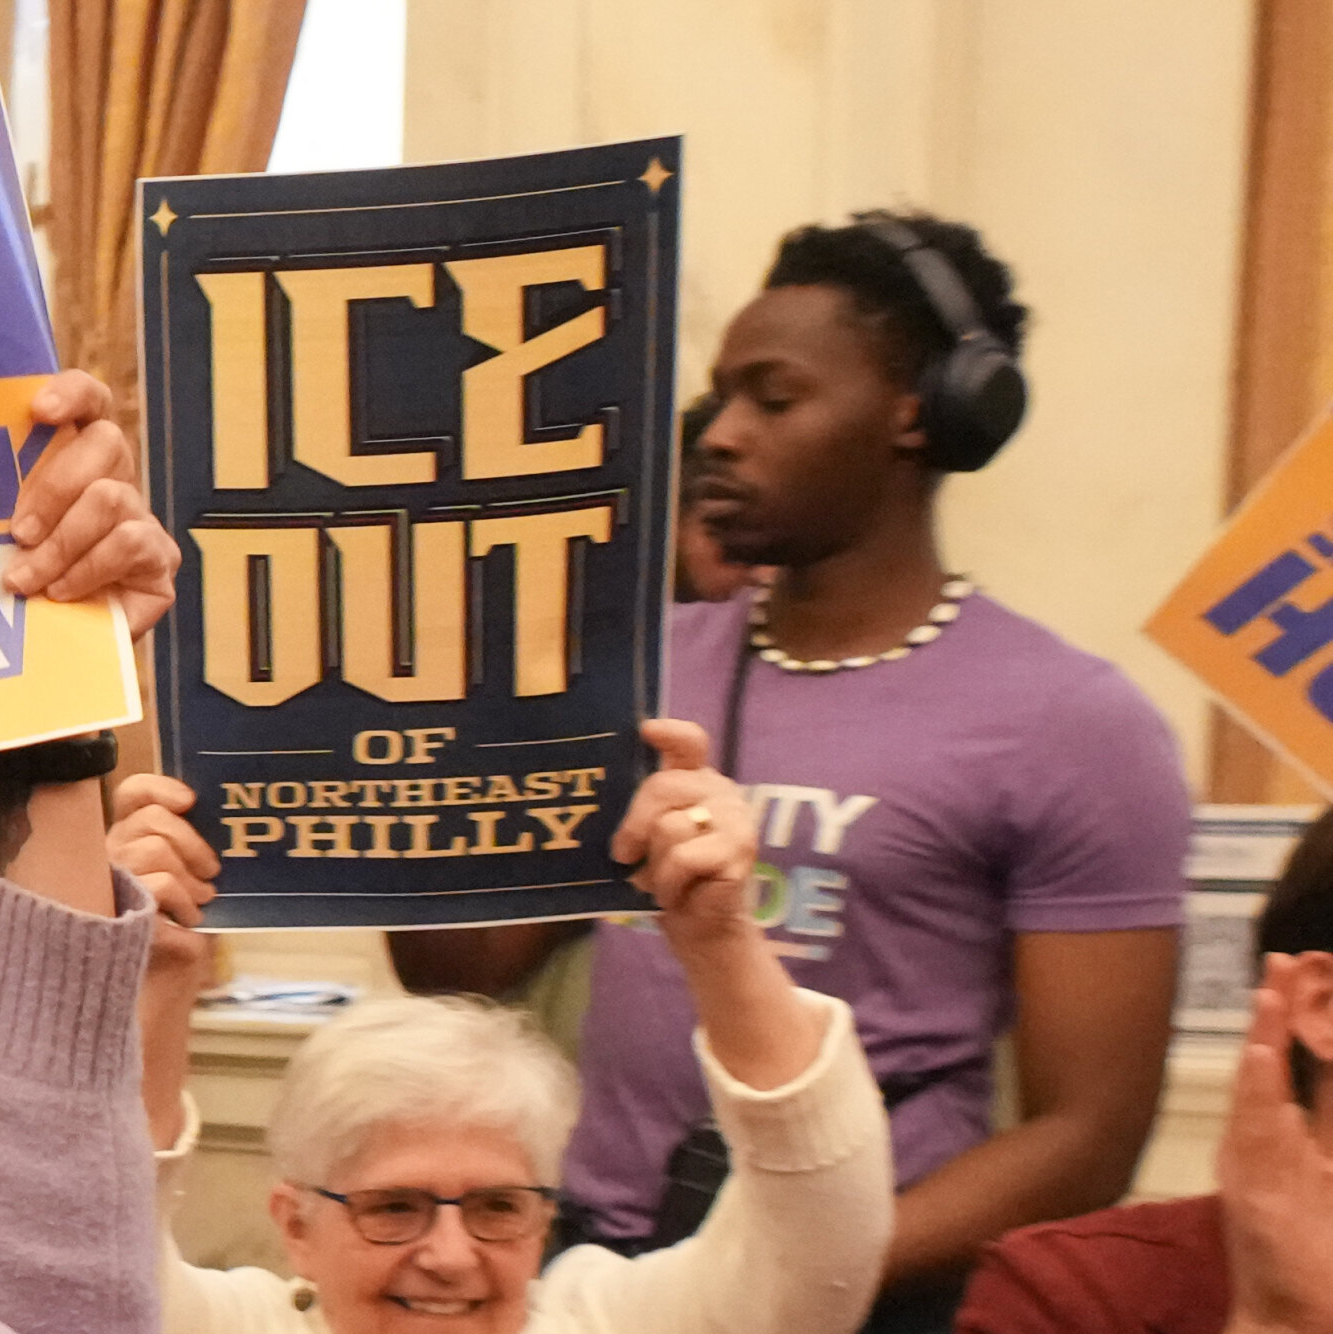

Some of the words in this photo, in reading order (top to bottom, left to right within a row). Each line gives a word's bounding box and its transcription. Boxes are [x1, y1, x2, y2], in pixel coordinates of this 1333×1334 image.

[194, 244, 608, 490] ICE
[187, 505, 614, 707] OUT
[352, 727, 457, 765] OF
[220, 766, 606, 810] NORTHEAST
[219, 804, 601, 860] PHILLY
